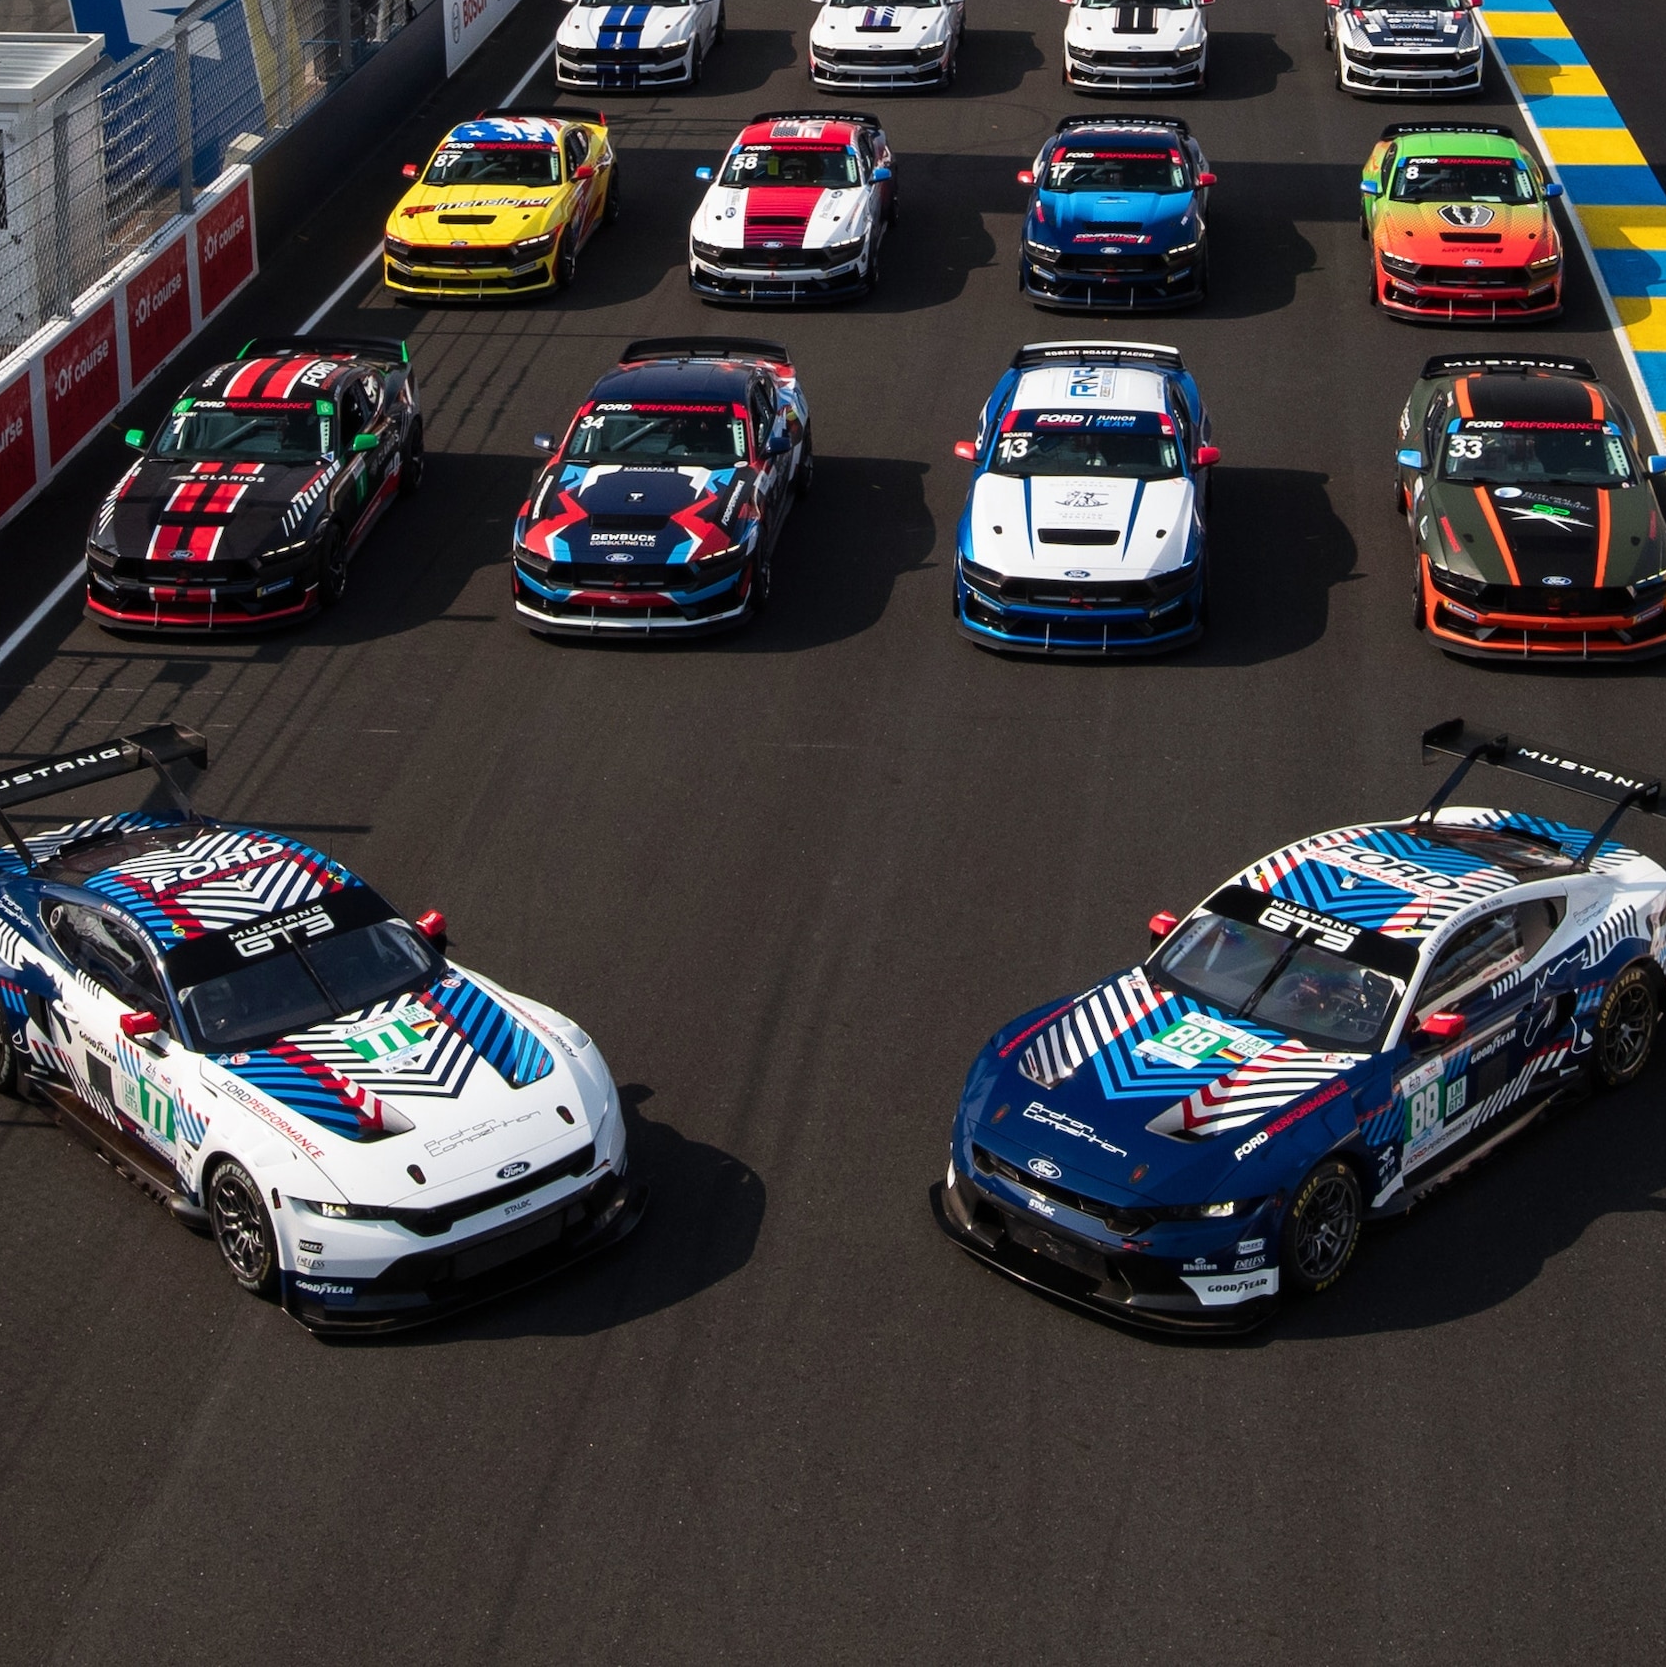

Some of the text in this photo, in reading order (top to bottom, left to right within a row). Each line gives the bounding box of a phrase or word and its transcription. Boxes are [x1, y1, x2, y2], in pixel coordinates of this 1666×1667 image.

[1069, 119, 1179, 127] MUSTANG
[434, 155, 461, 168] 87
[731, 157, 759, 170] 58
[1050, 165, 1075, 179] 17
[1405, 167, 1420, 180] 8
[219, 215, 245, 249] course
[152, 271, 182, 312] course
[74, 339, 110, 385] course
[1045, 349, 1080, 357] ROBERT
[1120, 351, 1155, 359] RACING
[301, 361, 339, 388] FORD
[1444, 359, 1575, 371] MUSTANG
[173, 417, 186, 434] 1
[580, 415, 606, 430] 34
[1037, 414, 1085, 423] FORD
[998, 439, 1028, 459] 13
[1448, 439, 1483, 459] 33
[199, 474, 266, 483] CLARIOS
[590, 533, 657, 542] DEWBUCK
[1517, 747, 1645, 790] MUSTAN
[149, 841, 285, 894] FORD
[1307, 851, 1439, 899] PERFORMANCE
[1323, 843, 1461, 891] FORD
[228, 905, 325, 940] MUSTANG
[1269, 899, 1362, 935] MUSTANG
[235, 913, 335, 958] GT3
[1257, 907, 1356, 953] GT3
[1600, 972, 1643, 1029] GOODYEAR
[399, 1005, 420, 1017] LM
[405, 1011, 430, 1023] GT3
[79, 1030, 118, 1064] GOODYEAR
[1160, 1025, 1221, 1057] 88
[1234, 1043, 1257, 1058] GT3
[1245, 1037, 1264, 1049] LM
[1470, 1029, 1517, 1065] GOODYEAR
[1449, 1083, 1463, 1102] LM
[1411, 1081, 1440, 1138] 88
[1447, 1095, 1464, 1115] GT3
[221, 1079, 326, 1160] FORDPERFORMANCE
[1028, 1101, 1095, 1134] Proton
[1234, 1079, 1349, 1162] FORDPERFORMANCE
[423, 1119, 497, 1149] Proton
[431, 1111, 542, 1158] Competition
[1023, 1109, 1128, 1158] Competition
[499, 1162, 529, 1180] Ford
[1031, 1161, 1059, 1178] Ford
[505, 1199, 532, 1216] STALOC
[1028, 1197, 1056, 1217] STALOC
[1293, 1177, 1319, 1219] EAGLE
[1233, 1254, 1266, 1270] ENDLESS
[295, 1279, 354, 1296] GOODYEAR
[1207, 1277, 1269, 1294] GOODYEAR
